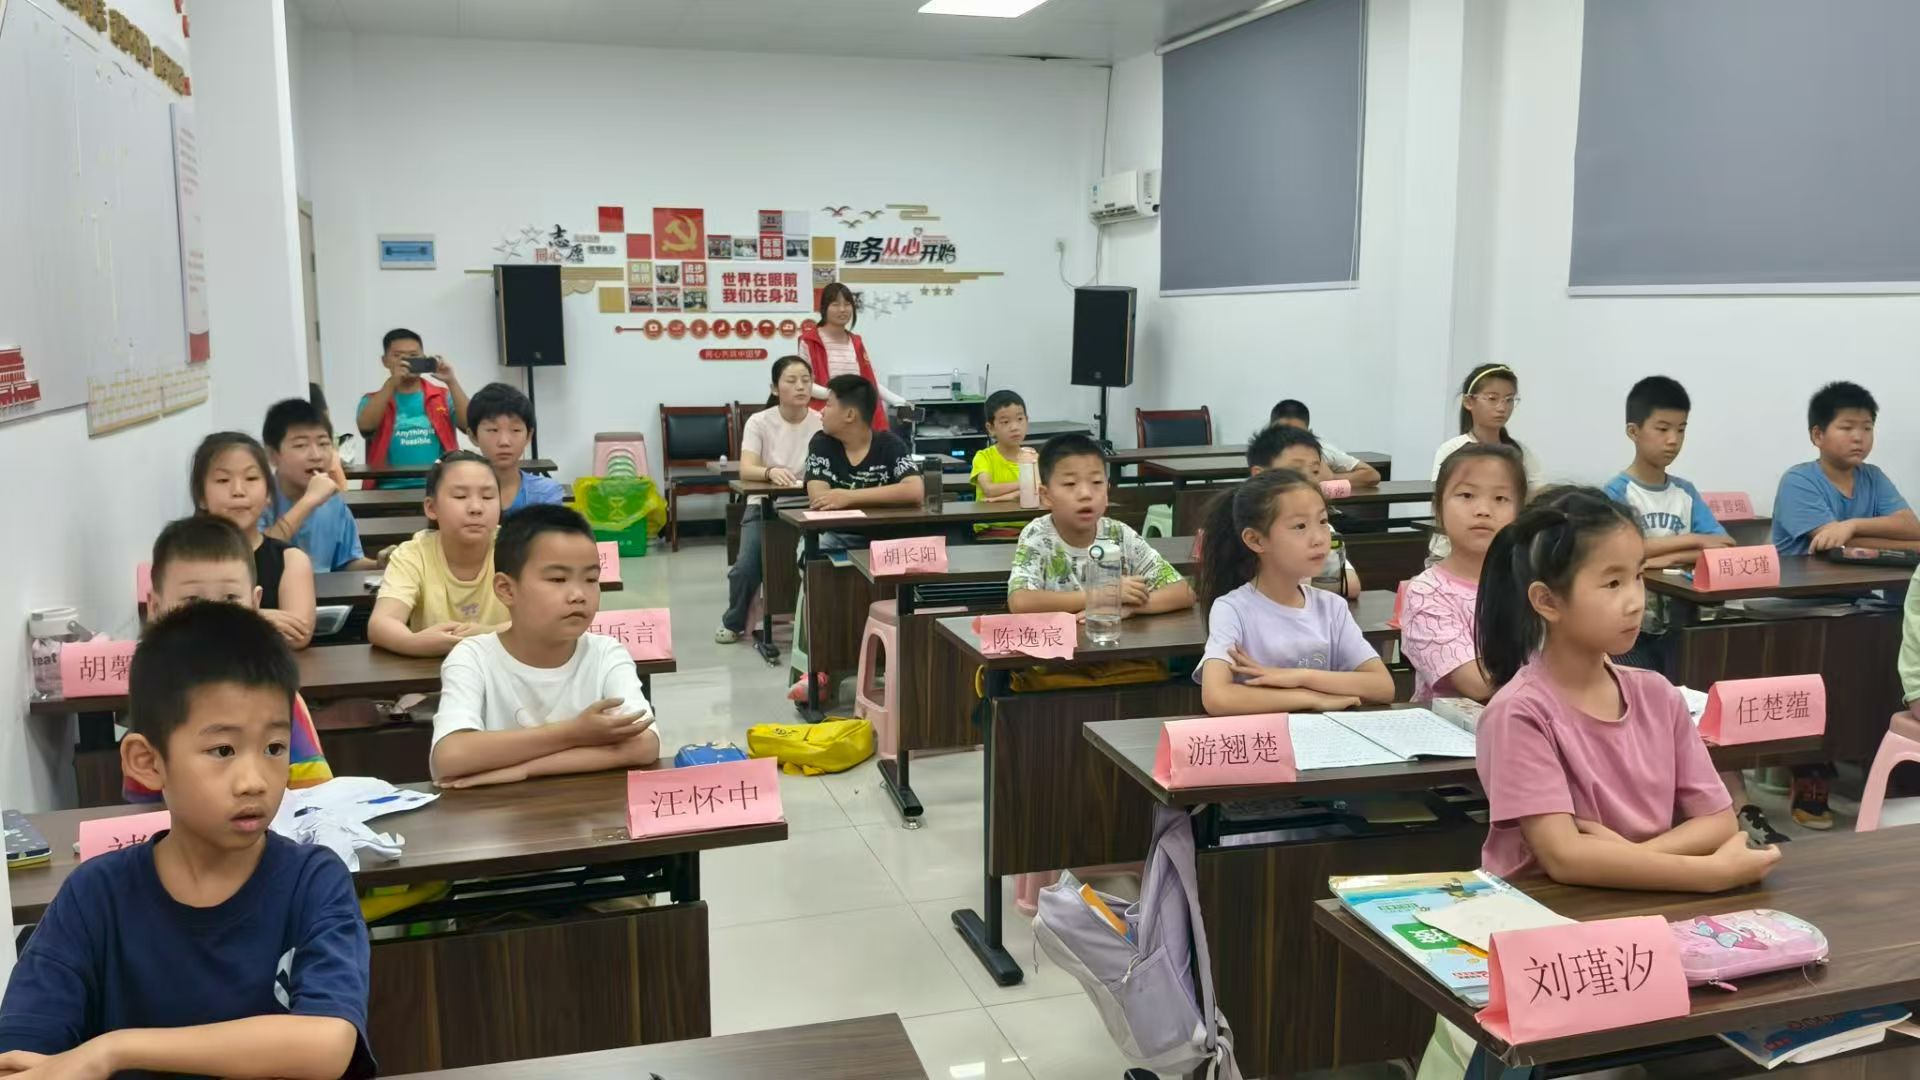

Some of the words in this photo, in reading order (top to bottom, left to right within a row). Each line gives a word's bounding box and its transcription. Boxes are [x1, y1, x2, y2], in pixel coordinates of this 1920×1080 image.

[840, 236, 957, 264] 服务从心开始
[722, 272, 798, 287] 世界在眼前
[722, 288, 798, 303] 我们在身边
[883, 545, 937, 565] 胡长阳
[1718, 555, 1770, 577] 周文瑾
[993, 625, 1065, 650] 陈逸宸
[1736, 690, 1811, 726] 任楚蕴
[1187, 731, 1280, 766] 游翘楚
[650, 780, 758, 818] 汪怀中
[1523, 943, 1653, 1004] 刘瑾汐
